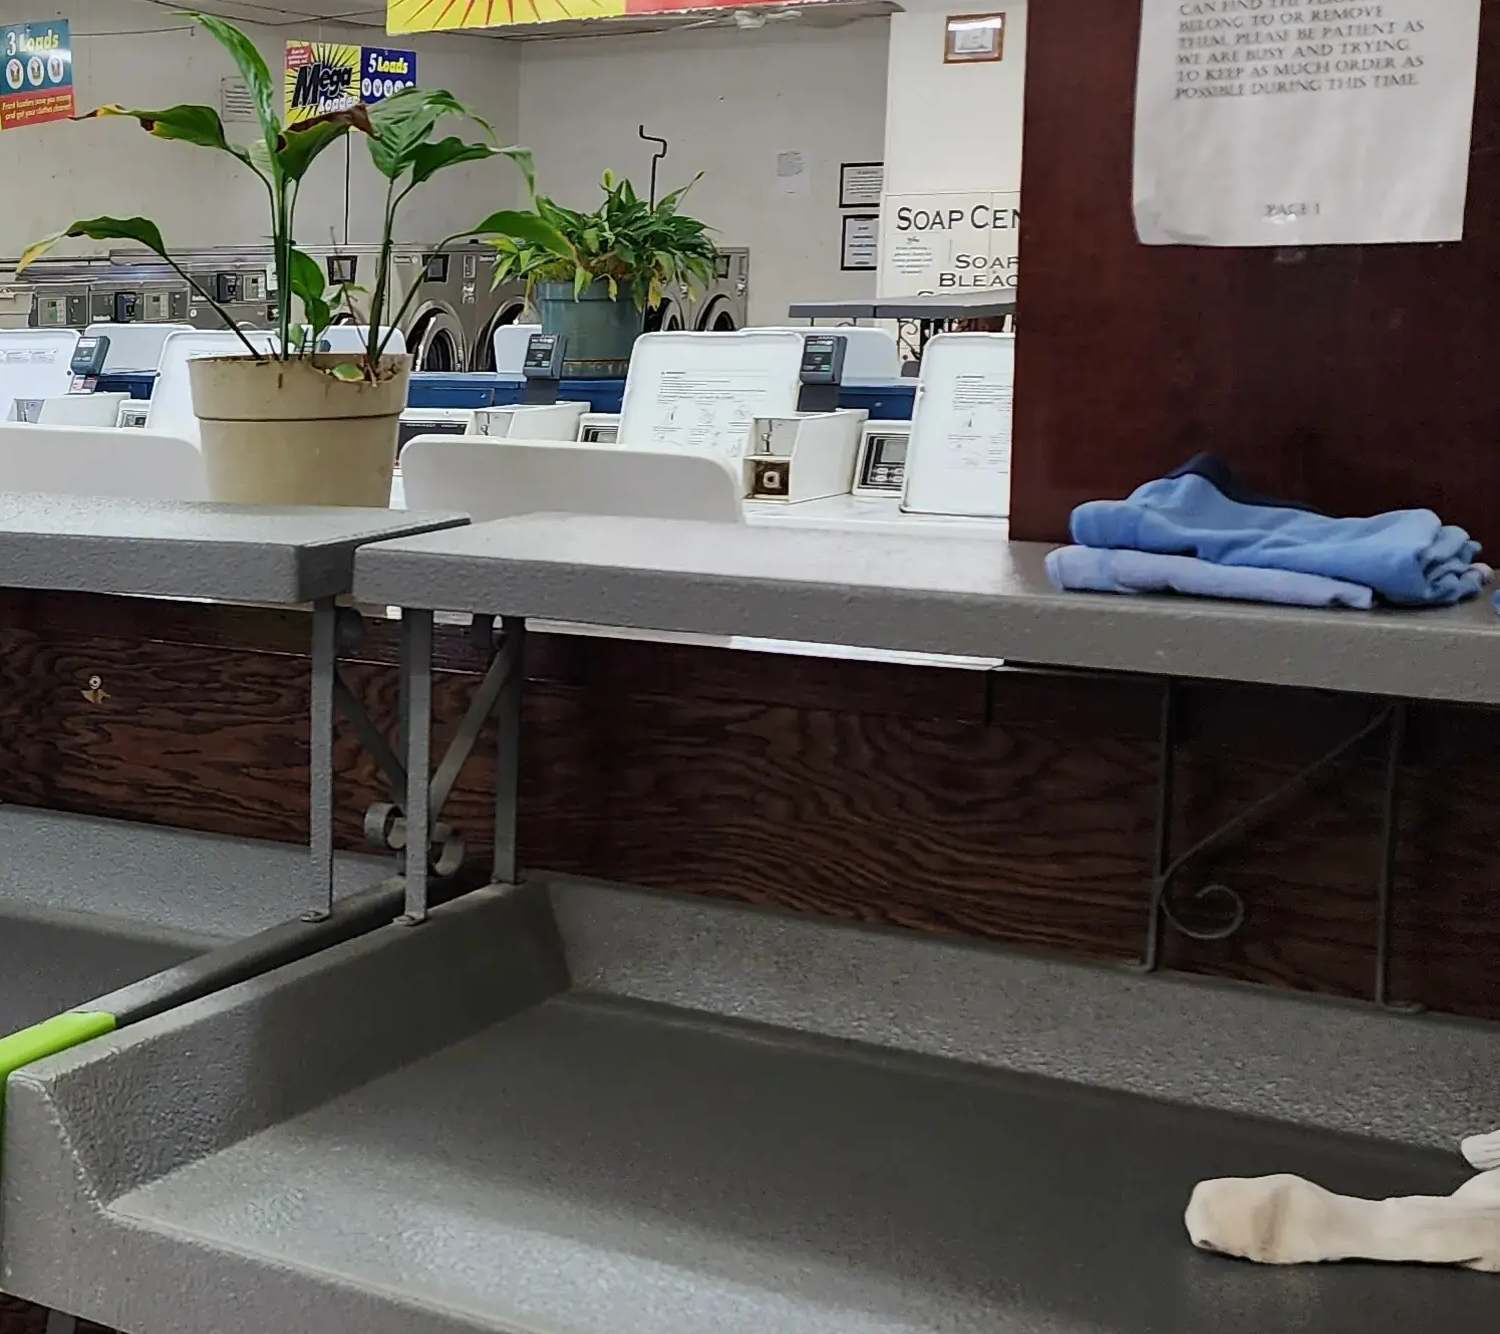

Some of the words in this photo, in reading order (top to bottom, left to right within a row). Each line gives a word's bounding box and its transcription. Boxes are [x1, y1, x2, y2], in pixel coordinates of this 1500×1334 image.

[1179, 16, 1245, 32] BELONG
[1251, 14, 1275, 27] TO
[1280, 11, 1304, 24] OR
[1311, 6, 1383, 22] REMOVE
[1180, 0, 1216, 15] CAN
[7, 32, 17, 56] 3
[18, 28, 59, 52] Loads
[1235, 30, 1289, 45] PLEASE
[1297, 28, 1315, 41] BE
[1322, 21, 1397, 38] PATIENT
[1403, 20, 1425, 33] AS
[368, 53, 377, 73] 5
[377, 56, 409, 74] Loads
[1176, 52, 1201, 65] WE
[1206, 50, 1240, 64] ARE
[1245, 47, 1285, 62] BUSY
[1292, 43, 1334, 58] AND
[1338, 38, 1411, 55] TRYING
[1178, 70, 1200, 83] TO
[1205, 67, 1245, 81] KEEP
[1250, 65, 1269, 78] AS
[1273, 60, 1330, 77] MUCH
[1336, 57, 1397, 73] ORDER
[1403, 55, 1425, 69] AS
[291, 62, 353, 109] Mega
[1175, 82, 1245, 100] POSSIBLE
[1252, 78, 1322, 95] DURING
[1328, 75, 1368, 91] THIS
[896, 206, 964, 231] SOAP
[938, 272, 1019, 287] BLEAC
